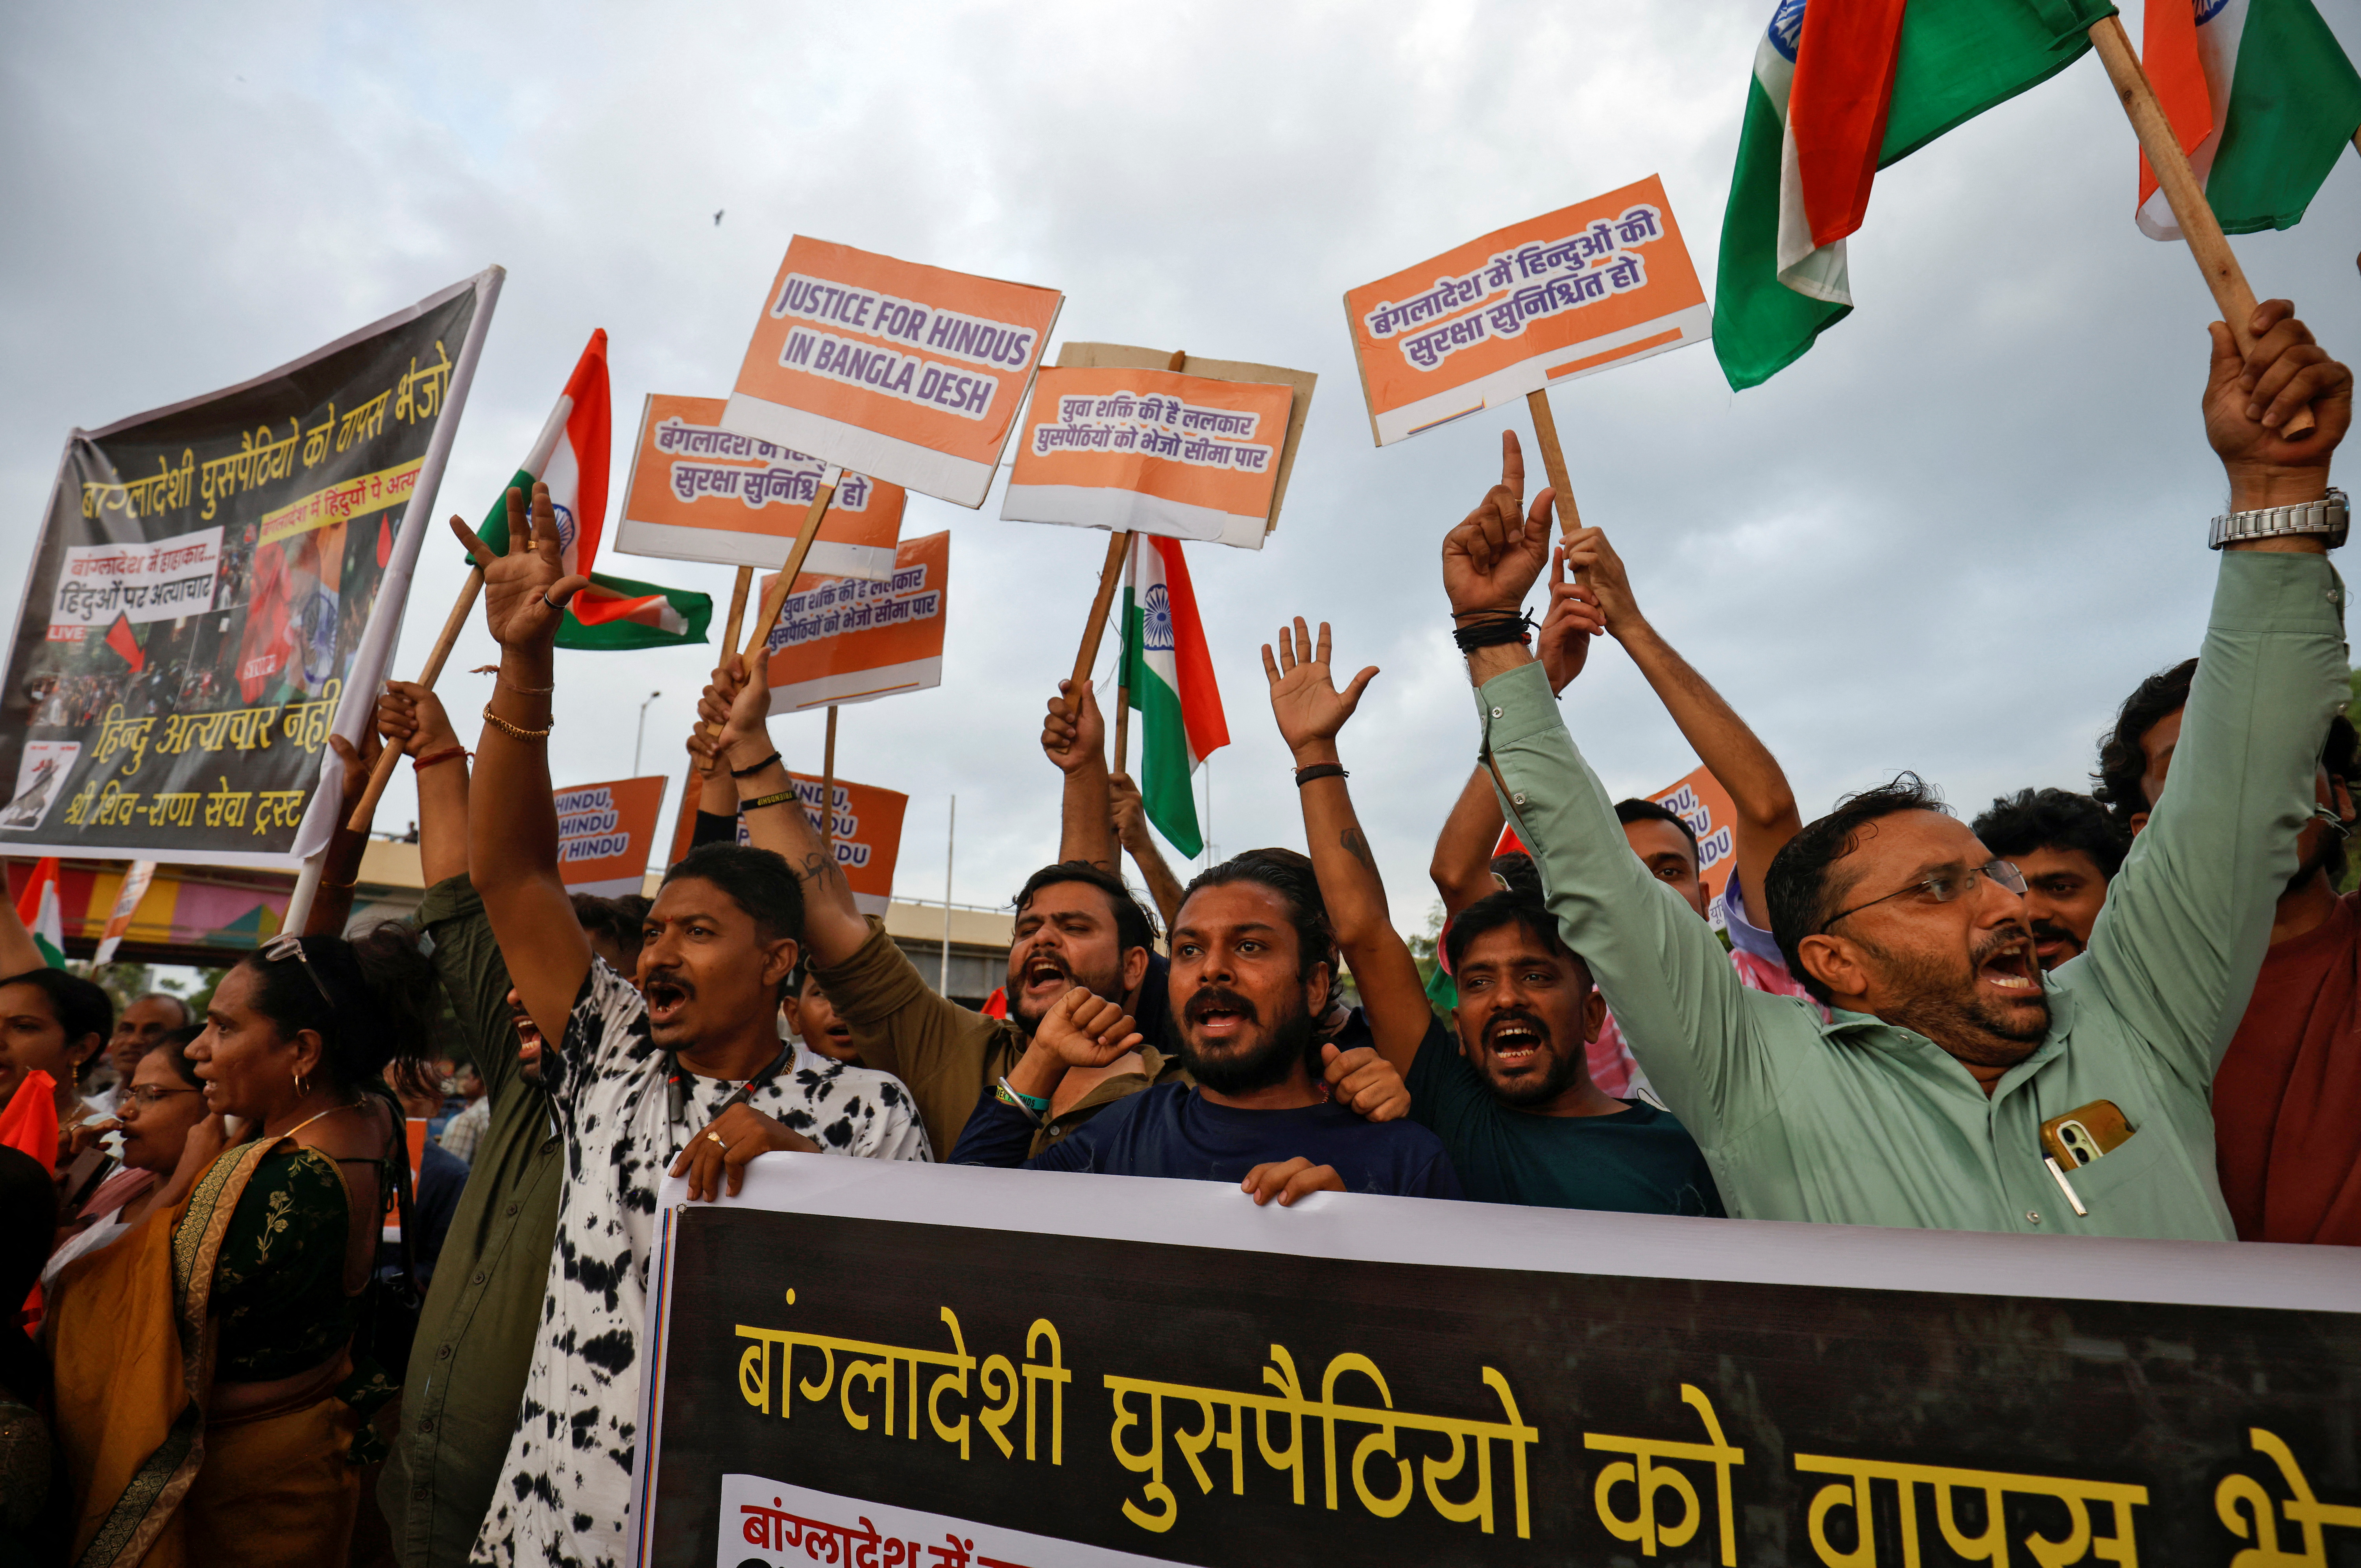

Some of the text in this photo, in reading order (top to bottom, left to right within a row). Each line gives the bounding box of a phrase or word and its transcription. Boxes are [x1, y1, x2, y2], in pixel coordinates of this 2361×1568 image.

[1371, 209, 1657, 334] बंगलादेश में हिन्दुओं की
[776, 279, 1031, 365] JUSTICE FOR HINDUS
[1405, 256, 1641, 367] सुरक्षा सुनिश्चित हो
[783, 332, 992, 414] IN BANGLA DESH
[1062, 395, 1254, 435] युवा शक्ति की है ललकार
[82, 447, 195, 519] बांग्लादेशी
[201, 416, 300, 520] घुसपैठियो
[303, 402, 336, 469] को
[336, 388, 392, 452] वापस
[1038, 424, 1267, 469] घुसपैठियों को भेजो सीमा पार
[310, 494, 321, 517] में
[371, 475, 382, 500] पे
[676, 467, 867, 507] सुरक्षा सुनिश्चि हो
[70, 549, 146, 576] बांग्लादेश
[146, 548, 161, 572] में
[59, 574, 213, 621] हिंदुओं पर अत्याचार
[783, 595, 806, 620] युवा
[808, 585, 837, 610] शक्ति
[838, 578, 856, 602] की
[48, 626, 85, 640] LIVE
[769, 594, 937, 651] घुसपैठियों को भेजो सीमा पार
[155, 706, 279, 754] अत्याचार
[63, 775, 305, 835] श्री शिव-राणा सेवा ट्रस्ट
[555, 790, 610, 812] HINDU,
[757, 791, 793, 806] FRIENDSHIP
[559, 814, 615, 836] HINDU
[568, 836, 626, 858] HINDU
[735, 1288, 1071, 1466] बांग्लादेशी
[1104, 1344, 1539, 1533] घुसपैठियो
[1584, 1383, 1745, 1568] को
[1794, 1453, 2149, 1568] वापस
[740, 1496, 921, 1568] बांग्लादेश
